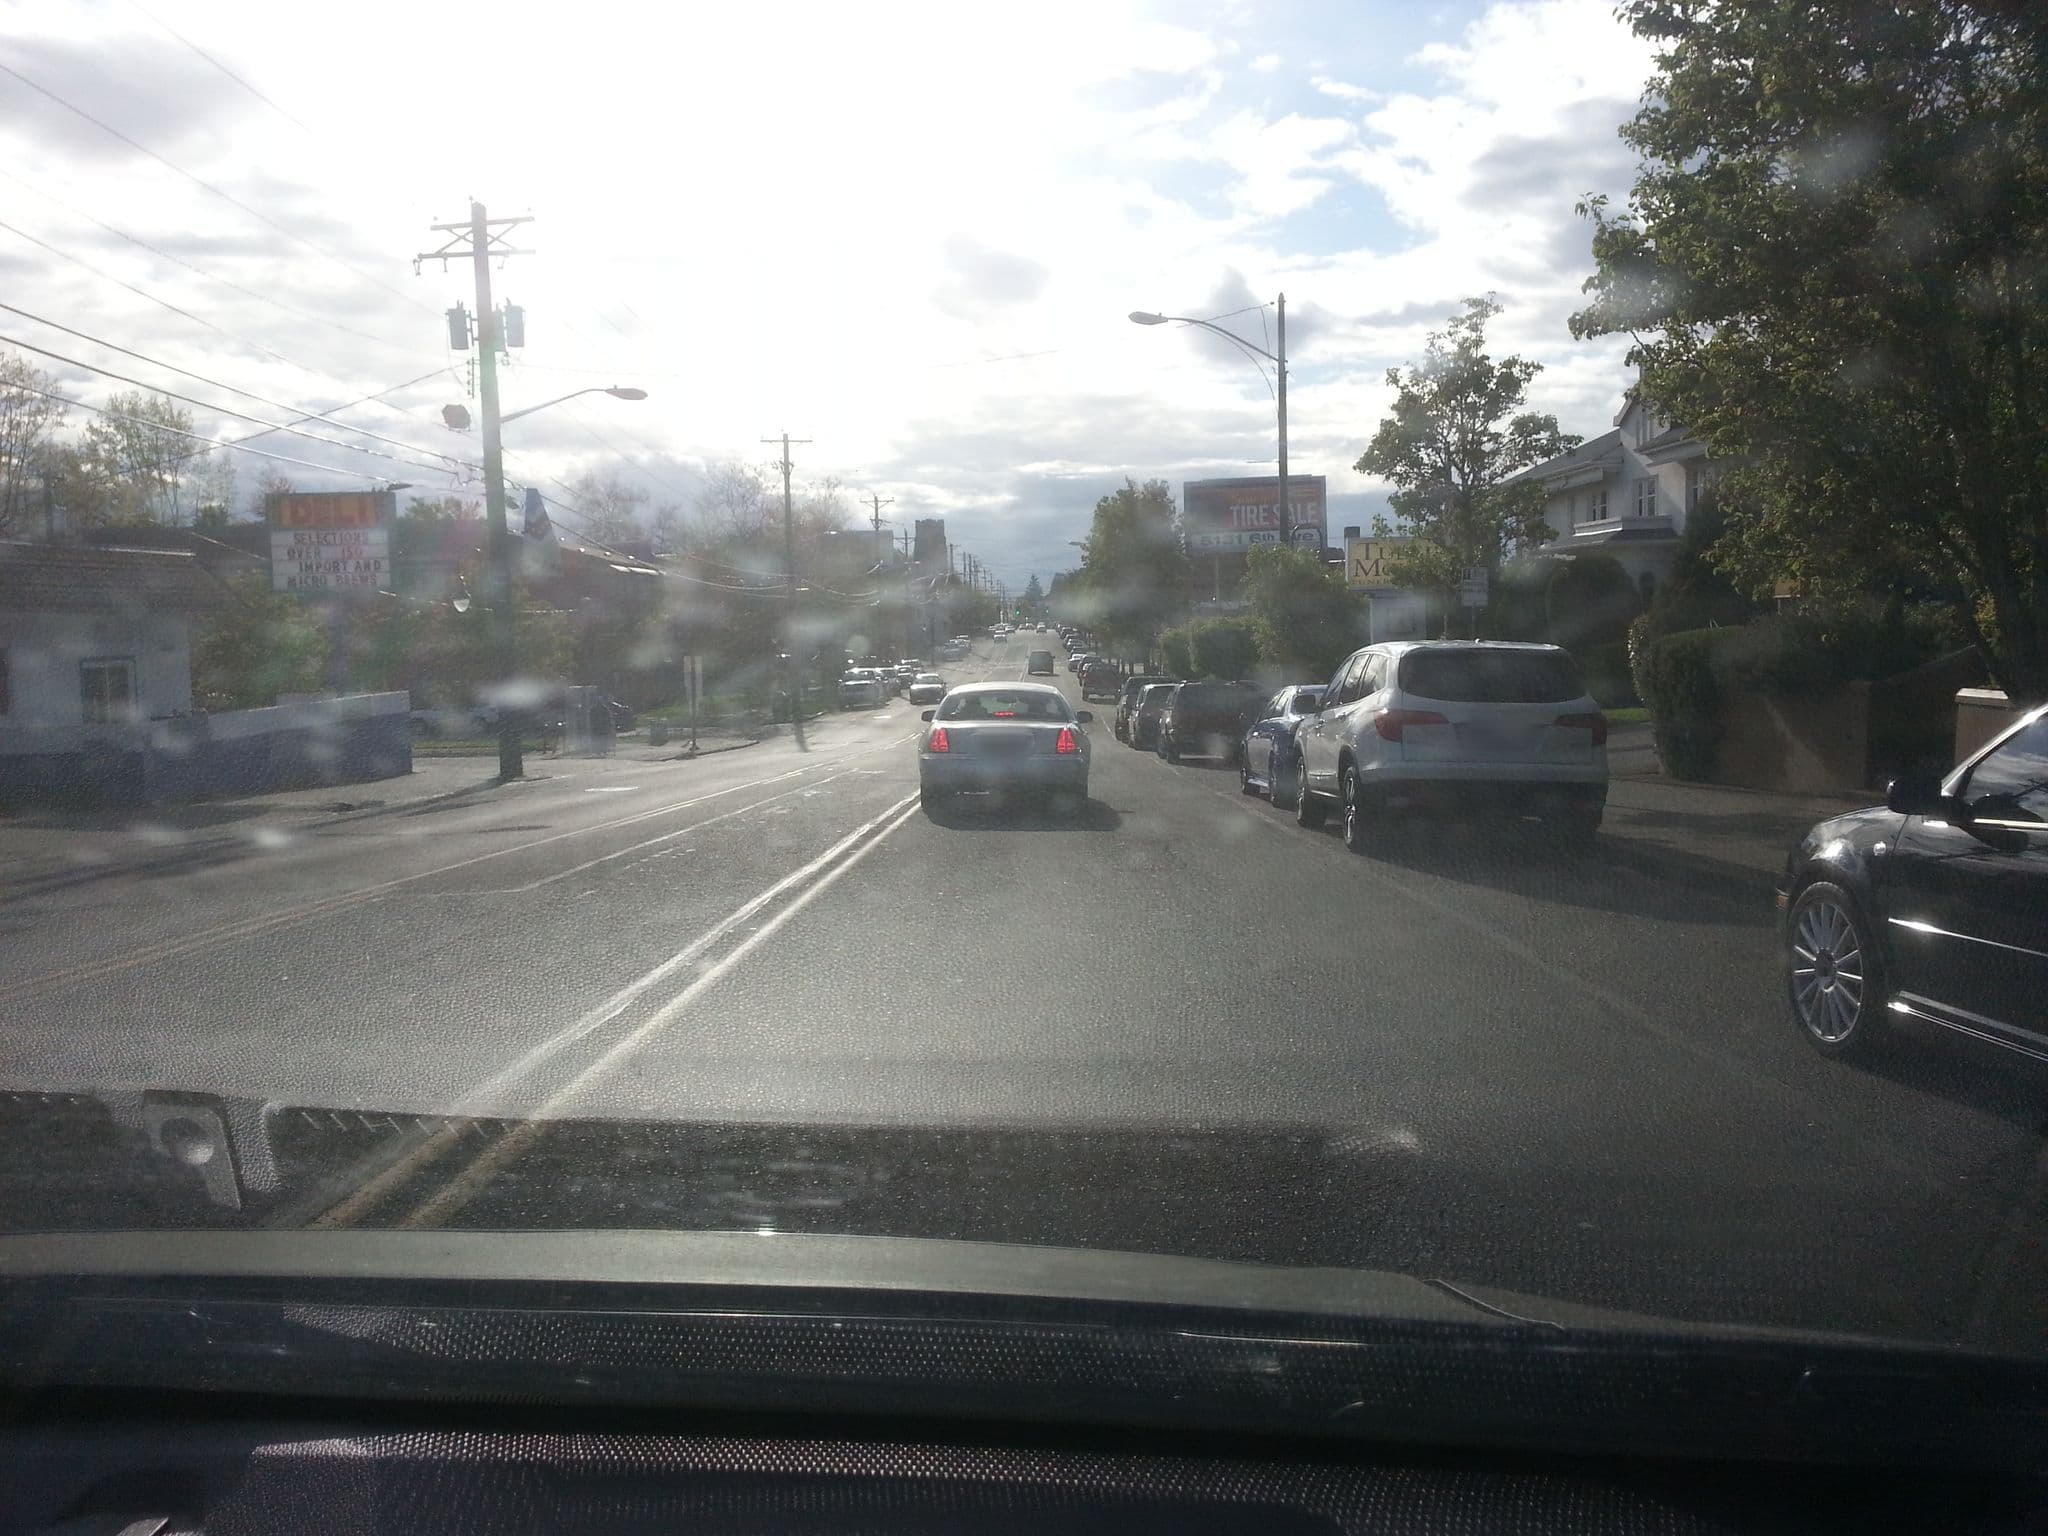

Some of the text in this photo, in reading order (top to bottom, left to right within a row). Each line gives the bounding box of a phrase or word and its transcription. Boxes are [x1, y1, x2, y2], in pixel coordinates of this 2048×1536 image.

[290, 498, 367, 523] DELI
[1230, 505, 1270, 527] TIRE
[293, 531, 369, 545] SELECTIONS
[1250, 532, 1275, 544] 6th
[286, 546, 363, 560] OVER 150
[299, 559, 381, 573] IMPORT AND
[287, 574, 377, 587] MICRO BREWS
